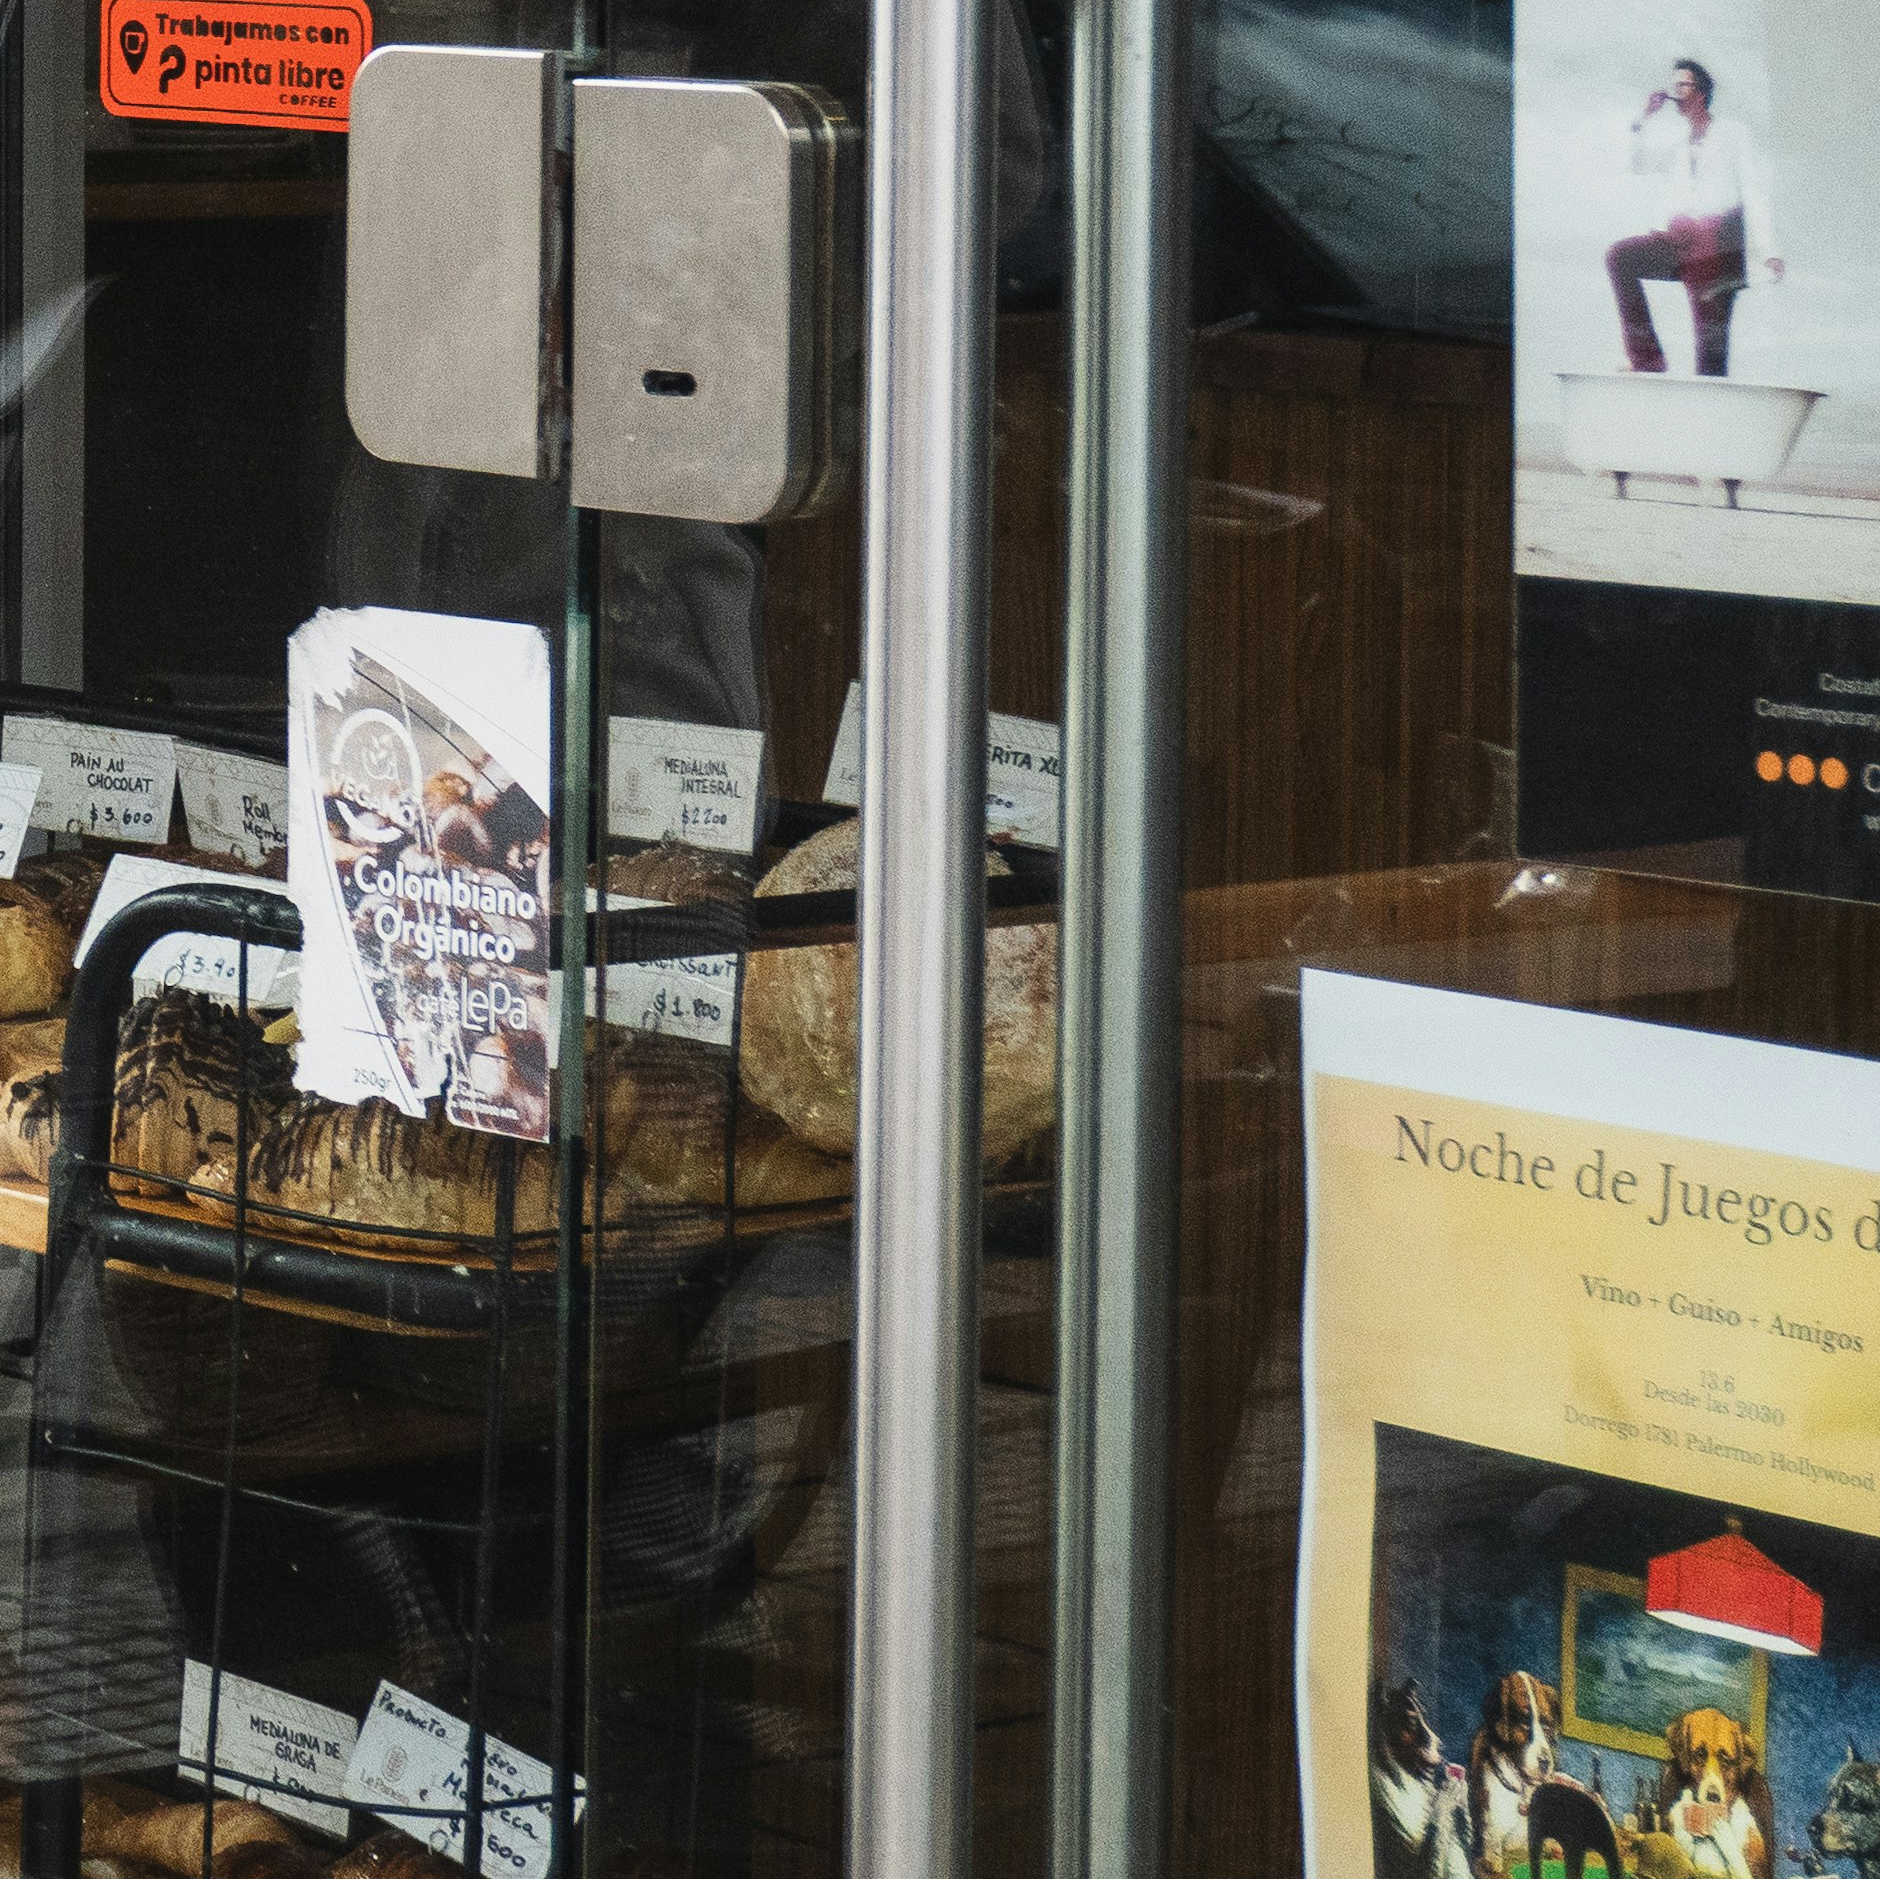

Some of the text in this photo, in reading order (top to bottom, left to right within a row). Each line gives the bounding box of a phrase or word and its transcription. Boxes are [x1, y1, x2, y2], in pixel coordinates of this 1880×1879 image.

[154, 11, 351, 46] Trabajamos con
[194, 53, 346, 92] pinta libre
[278, 93, 338, 109] COFFEE
[86, 772, 154, 793] CHOCOLAT
[106, 757, 125, 772] AU
[680, 777, 742, 799] INTEGRAL
[353, 855, 537, 921] Colombiano
[373, 905, 516, 965] Orgánico
[1393, 1113, 1836, 1248] Noche de Juegos
[1580, 1273, 1642, 1308] Vino
[1668, 1291, 1741, 1328] Guiso
[1769, 1314, 1865, 1355] Amigos
[1642, 1377, 1701, 1409] Desde
[1705, 1392, 1731, 1415] las
[1562, 1404, 1641, 1441] Dorrego
[1685, 1432, 1765, 1467] Palermo
[1769, 1450, 1877, 1493] Hollywood
[248, 1713, 343, 1759] MEDIALUNA DE
[274, 1740, 318, 1774] GRASA
